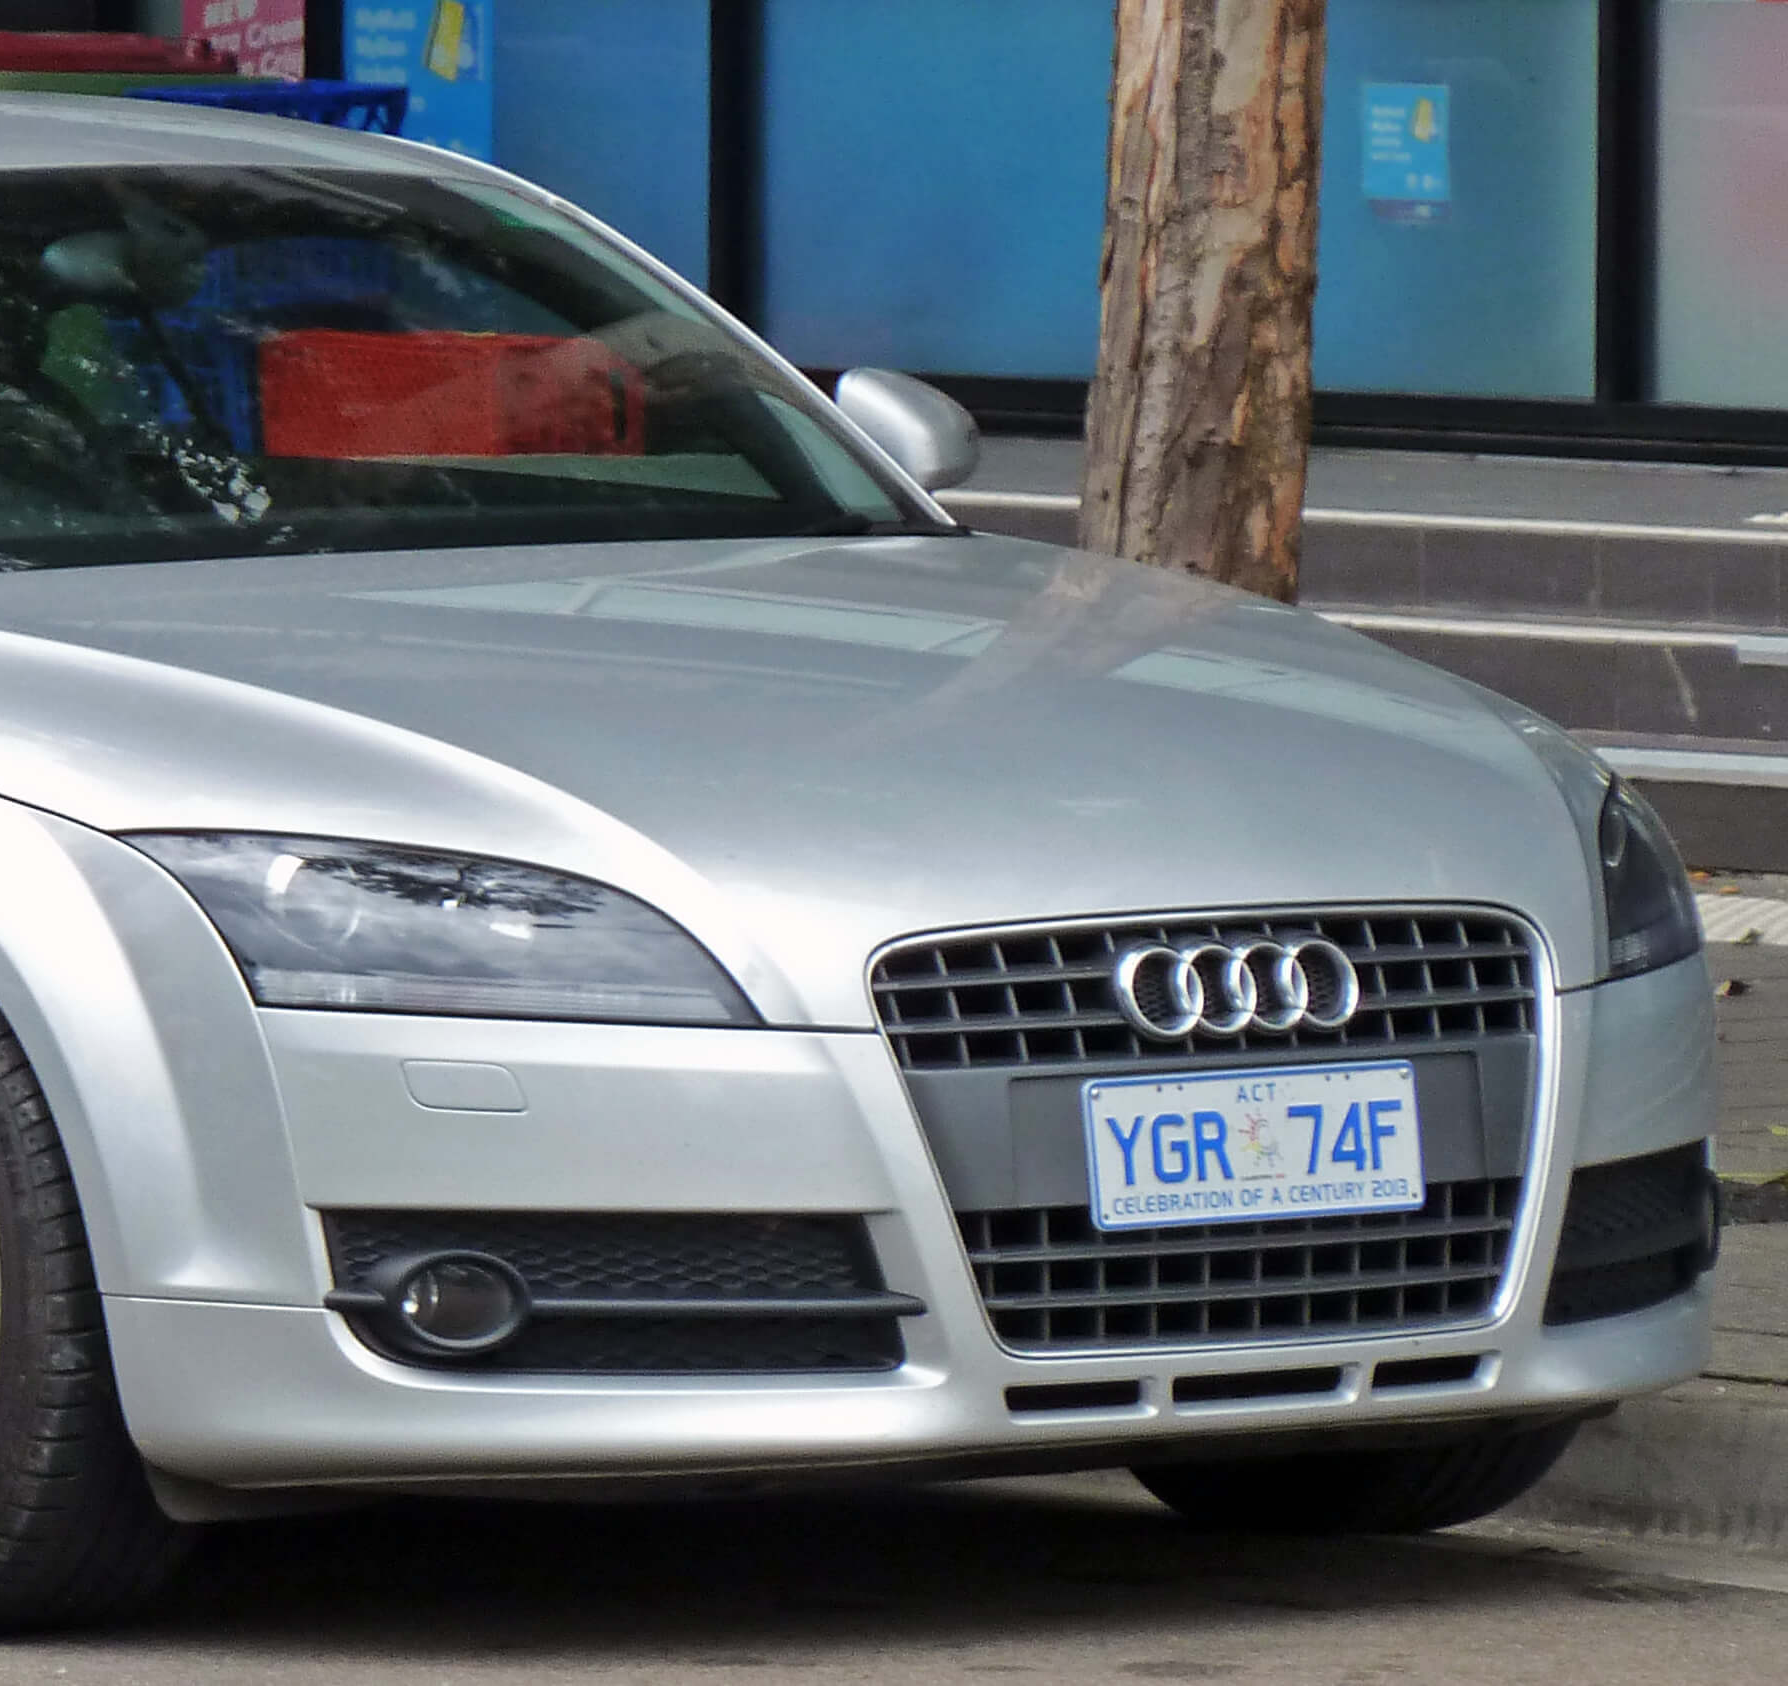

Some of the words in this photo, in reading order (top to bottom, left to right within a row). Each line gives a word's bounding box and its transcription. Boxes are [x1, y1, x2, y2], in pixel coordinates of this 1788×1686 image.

[1236, 1082, 1277, 1103] ACT
[1106, 1109, 1235, 1187] YGR
[1286, 1099, 1403, 1176] 74F
[1113, 1190, 1234, 1216] CELEBRATION
[1240, 1187, 1264, 1207] OF
[1271, 1186, 1284, 1205] A
[1289, 1180, 1365, 1203] CENTURY
[1371, 1177, 1409, 1198] 2013
